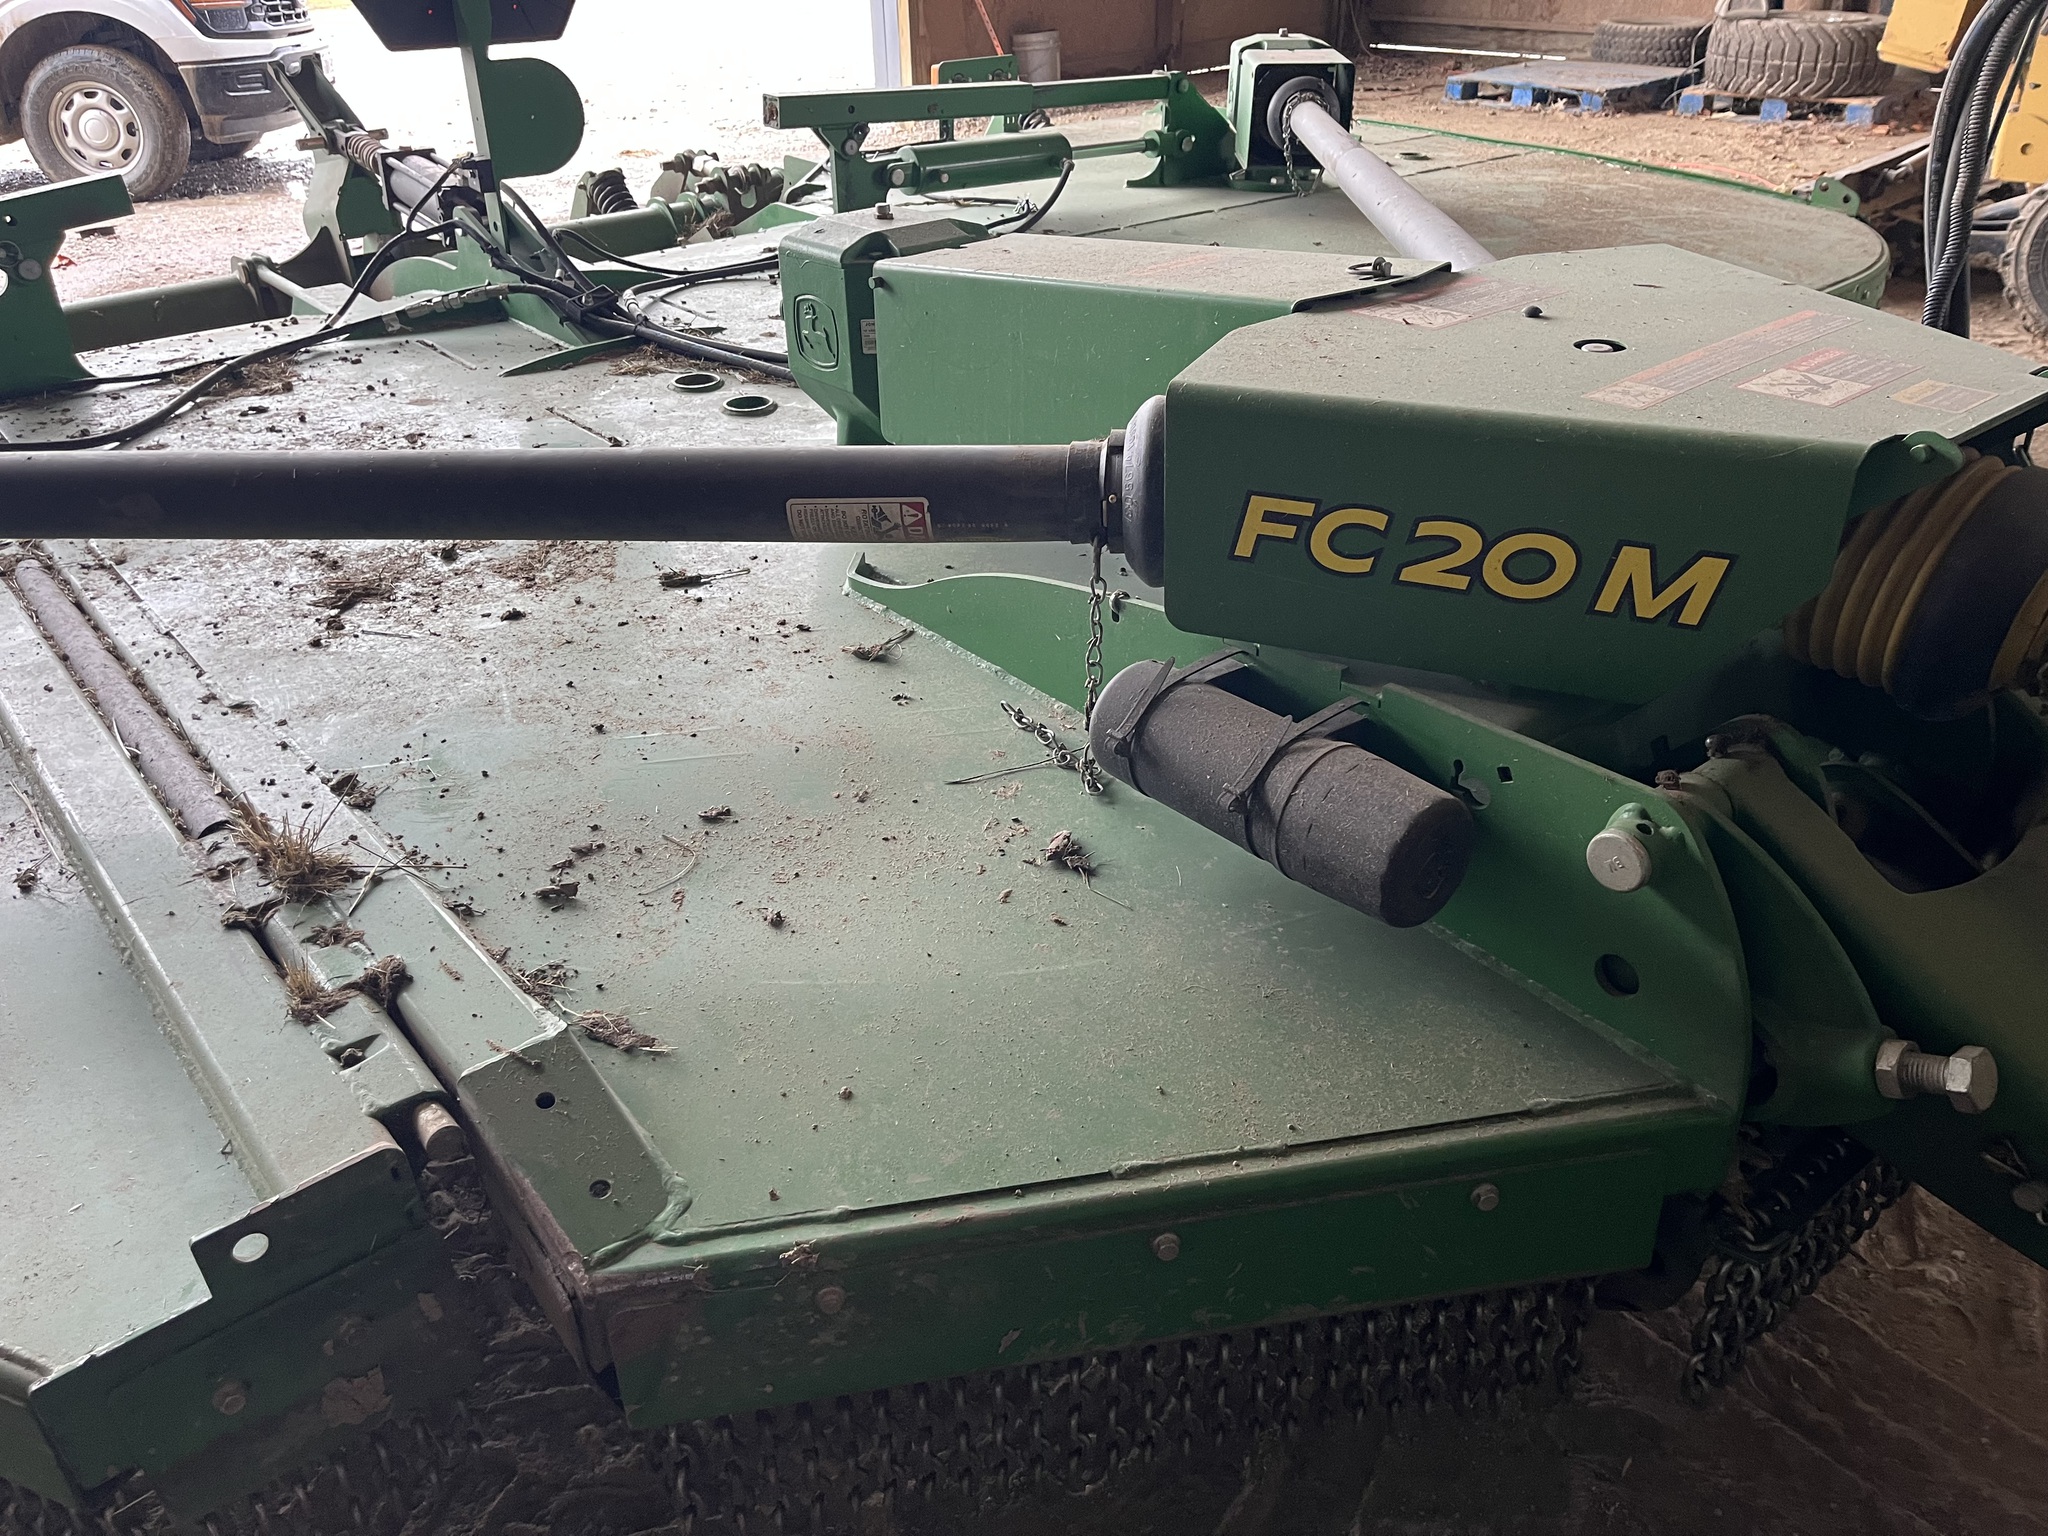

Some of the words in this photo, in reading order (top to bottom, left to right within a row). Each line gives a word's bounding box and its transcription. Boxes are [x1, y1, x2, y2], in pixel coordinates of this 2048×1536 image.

[1235, 495, 1389, 575] FC
[1399, 520, 1578, 600] 20
[1595, 546, 1730, 626] M
